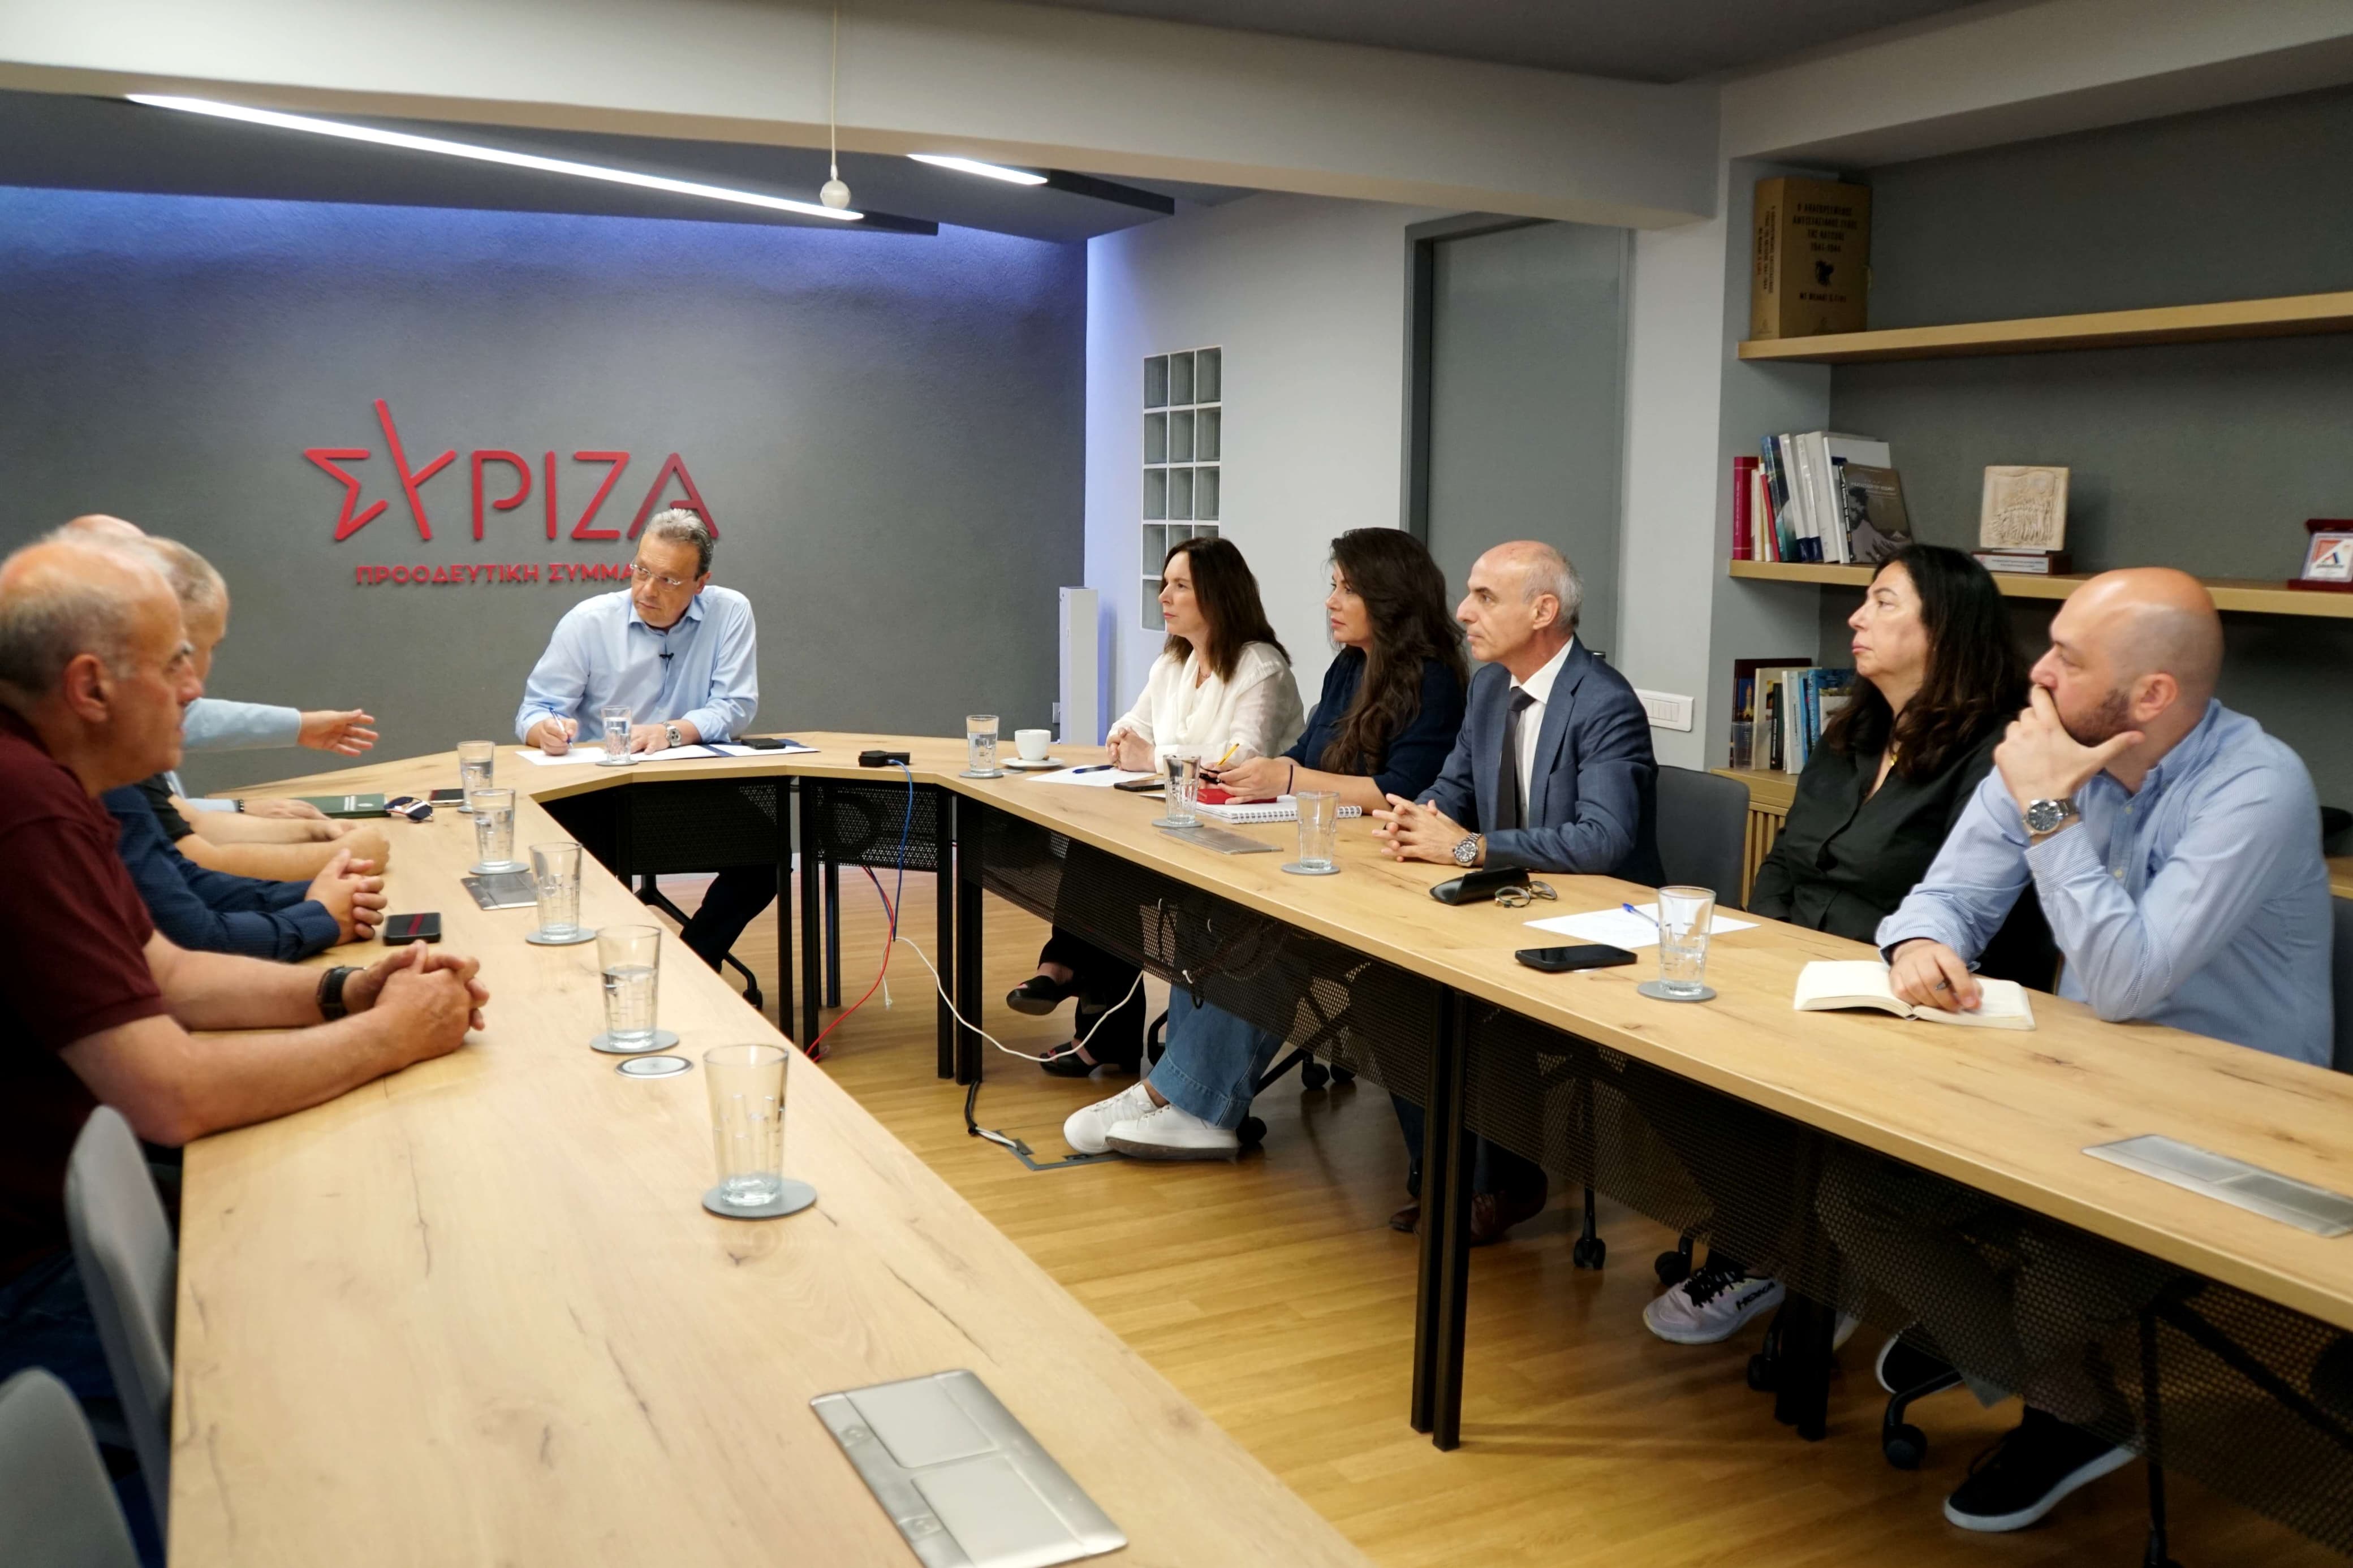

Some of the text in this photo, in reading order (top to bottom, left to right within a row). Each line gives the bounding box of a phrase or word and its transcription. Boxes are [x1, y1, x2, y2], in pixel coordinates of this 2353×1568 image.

[304, 398, 719, 541] ΣΥΡΙΖΑ
[356, 564, 539, 585] ΠΡΟΟΔΕΥΤΙΚΗ
[1736, 1281, 1775, 1311] HOKA
